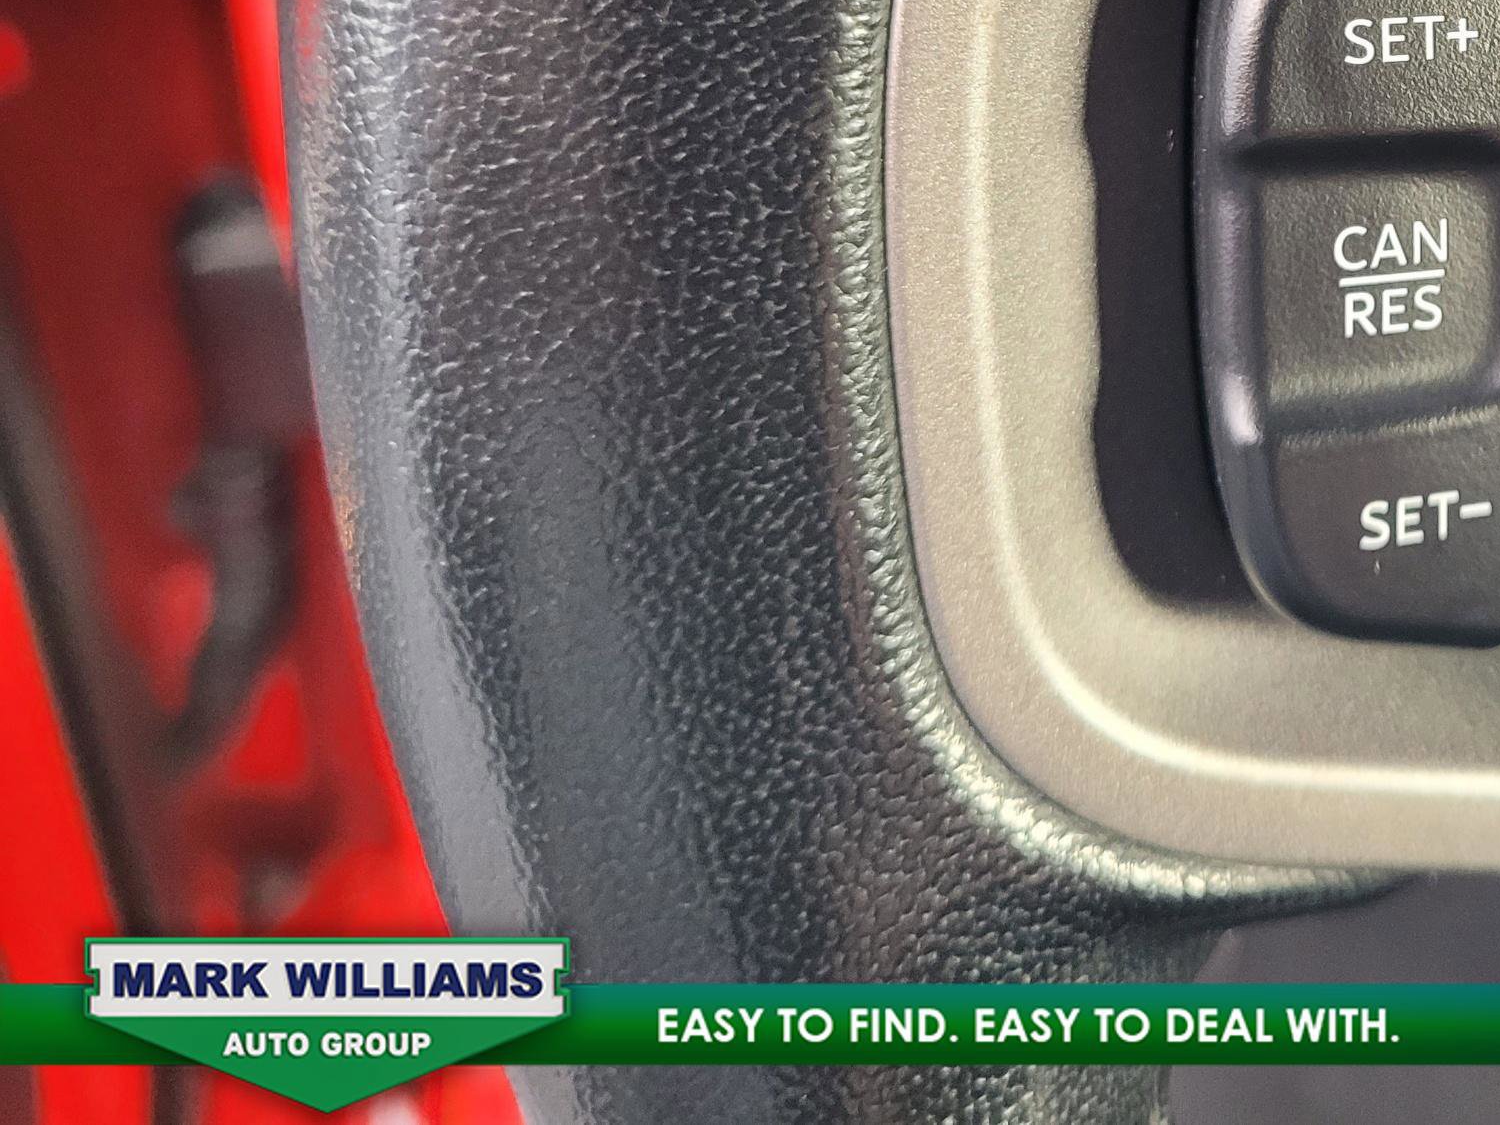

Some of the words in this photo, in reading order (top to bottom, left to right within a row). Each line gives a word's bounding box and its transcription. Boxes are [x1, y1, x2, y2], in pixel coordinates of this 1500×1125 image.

[1343, 13, 1479, 65] SET+
[1333, 218, 1449, 271] CAN
[1343, 284, 1443, 338] RES
[1359, 490, 1493, 551] SET-
